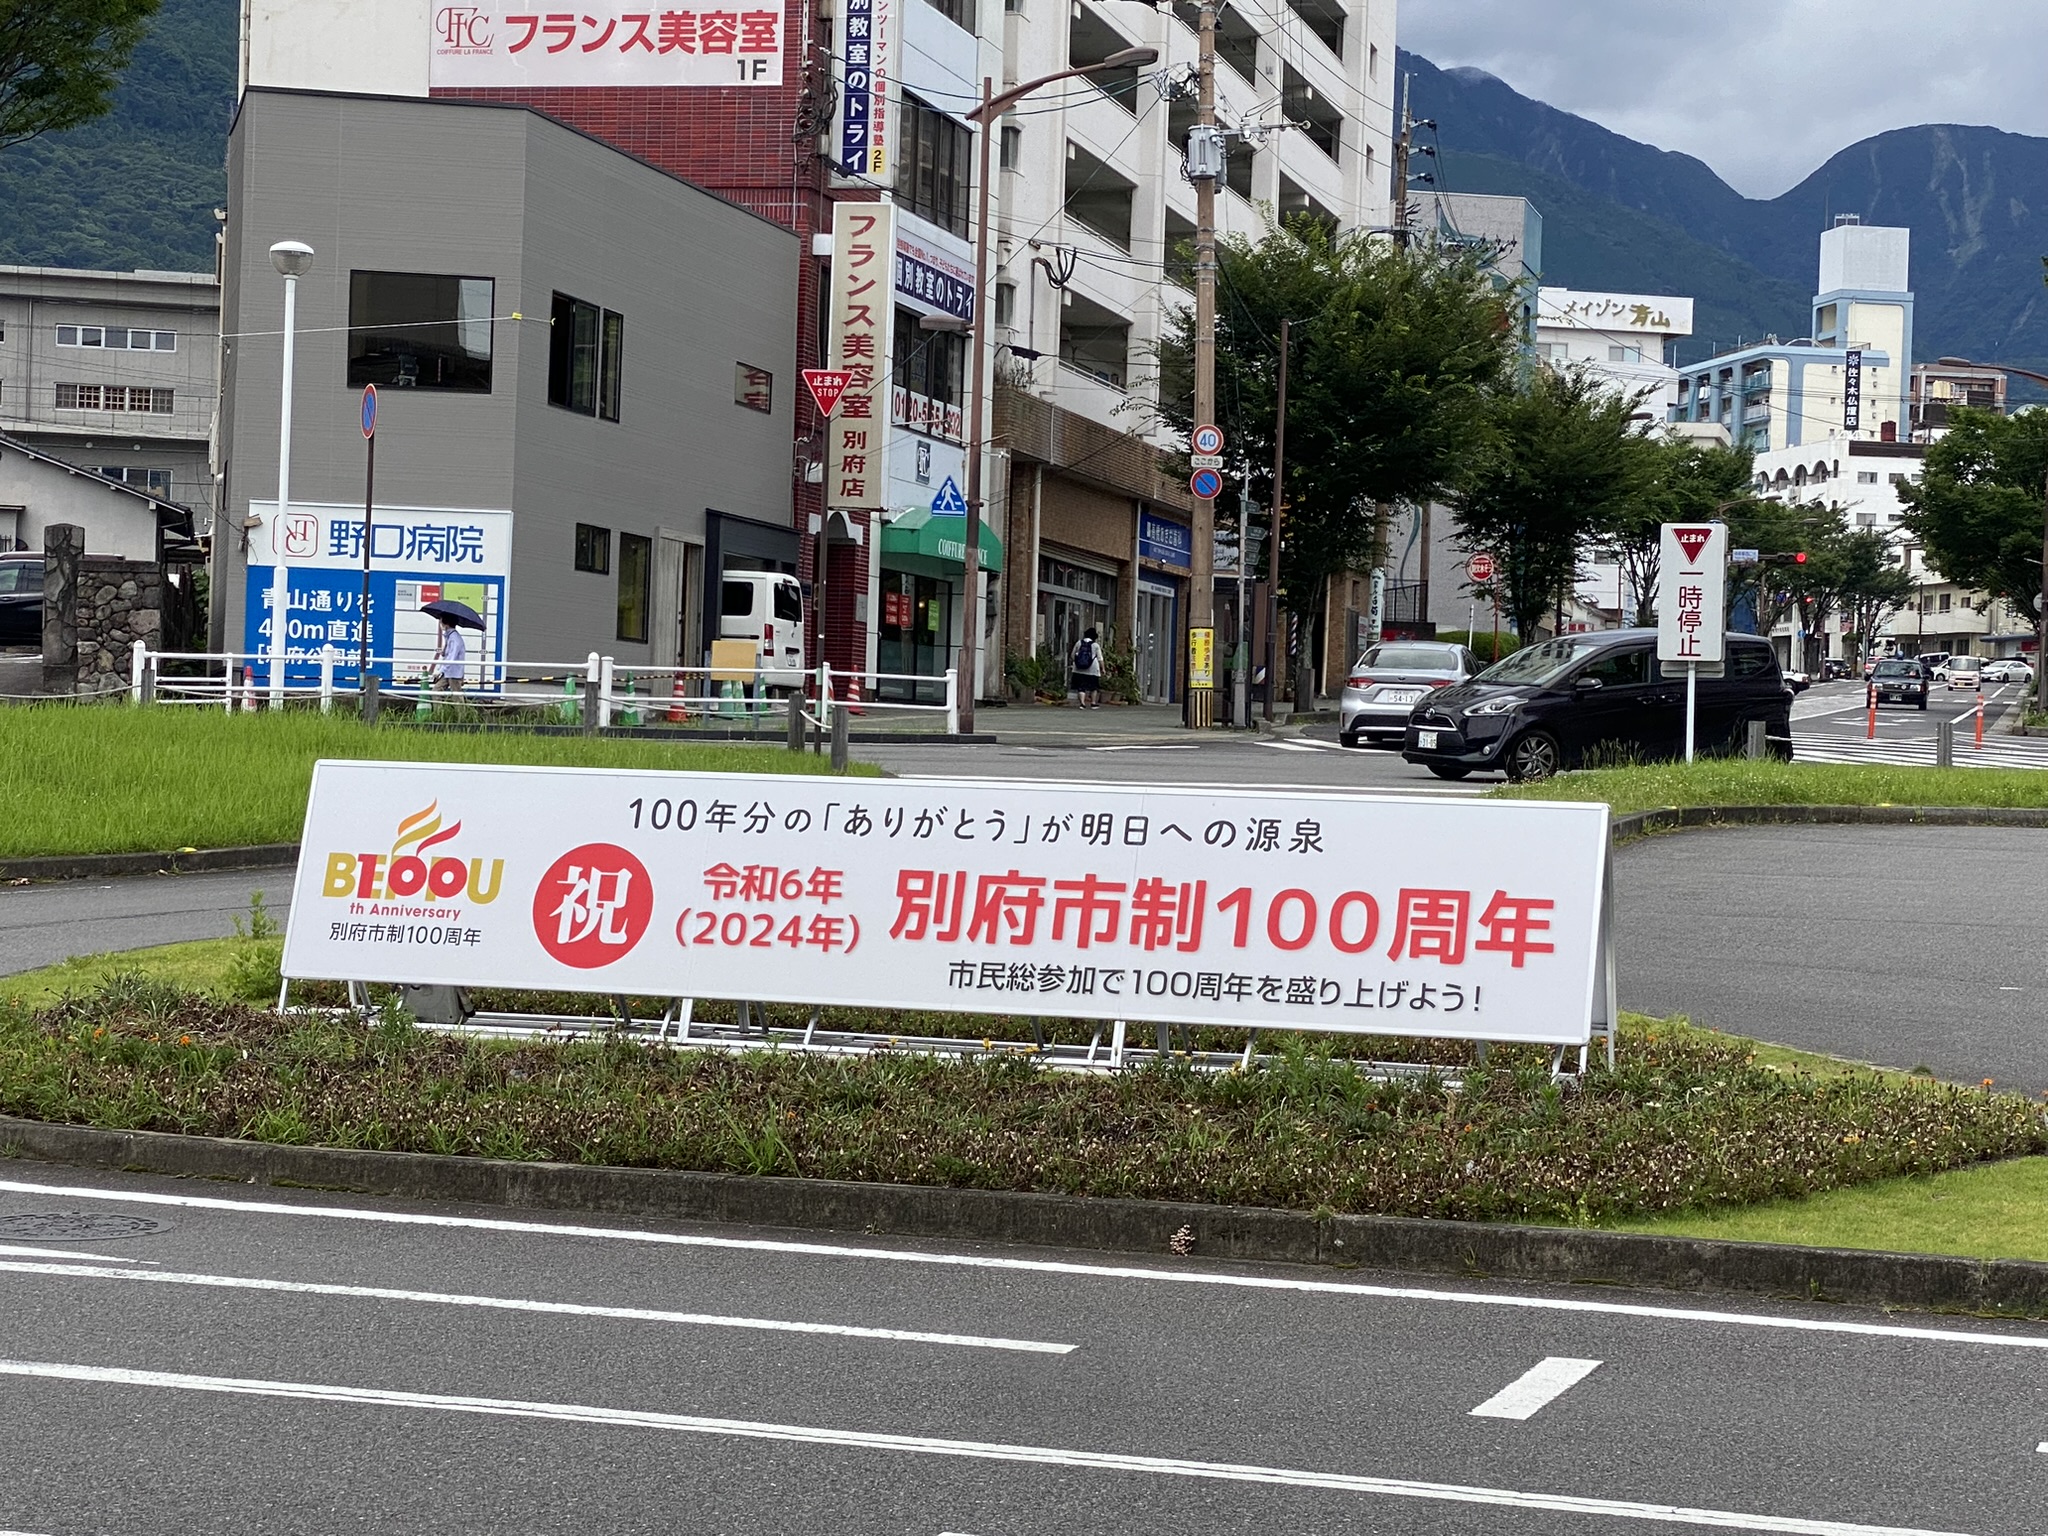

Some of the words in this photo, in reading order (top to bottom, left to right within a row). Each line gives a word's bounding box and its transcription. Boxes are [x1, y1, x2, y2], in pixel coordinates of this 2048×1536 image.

[505, 10, 779, 55] フランス美容室
[737, 60, 767, 80] 1F
[842, 215, 877, 419] フランス美容室
[812, 375, 843, 386] 止まれ
[817, 388, 839, 398] STOP
[1200, 433, 1217, 447] 40
[840, 431, 867, 497] 別府店
[328, 520, 484, 564] 野口病院
[1680, 534, 1705, 543] 止まれ
[258, 617, 374, 643] 40m直進
[1676, 570, 1704, 657] 一時停止
[629, 798, 1324, 854] 100年分の「ありがとう」が明日への源泉
[703, 862, 844, 905] 令和6年
[349, 902, 364, 915] th
[369, 904, 461, 922] Anniversary
[549, 865, 633, 946] 祝
[889, 868, 1555, 969] 別府市制100周年
[328, 922, 482, 947] 別府市制100周年
[948, 959, 1481, 1013] 市民総参加で100周年を盛り上げよう!
